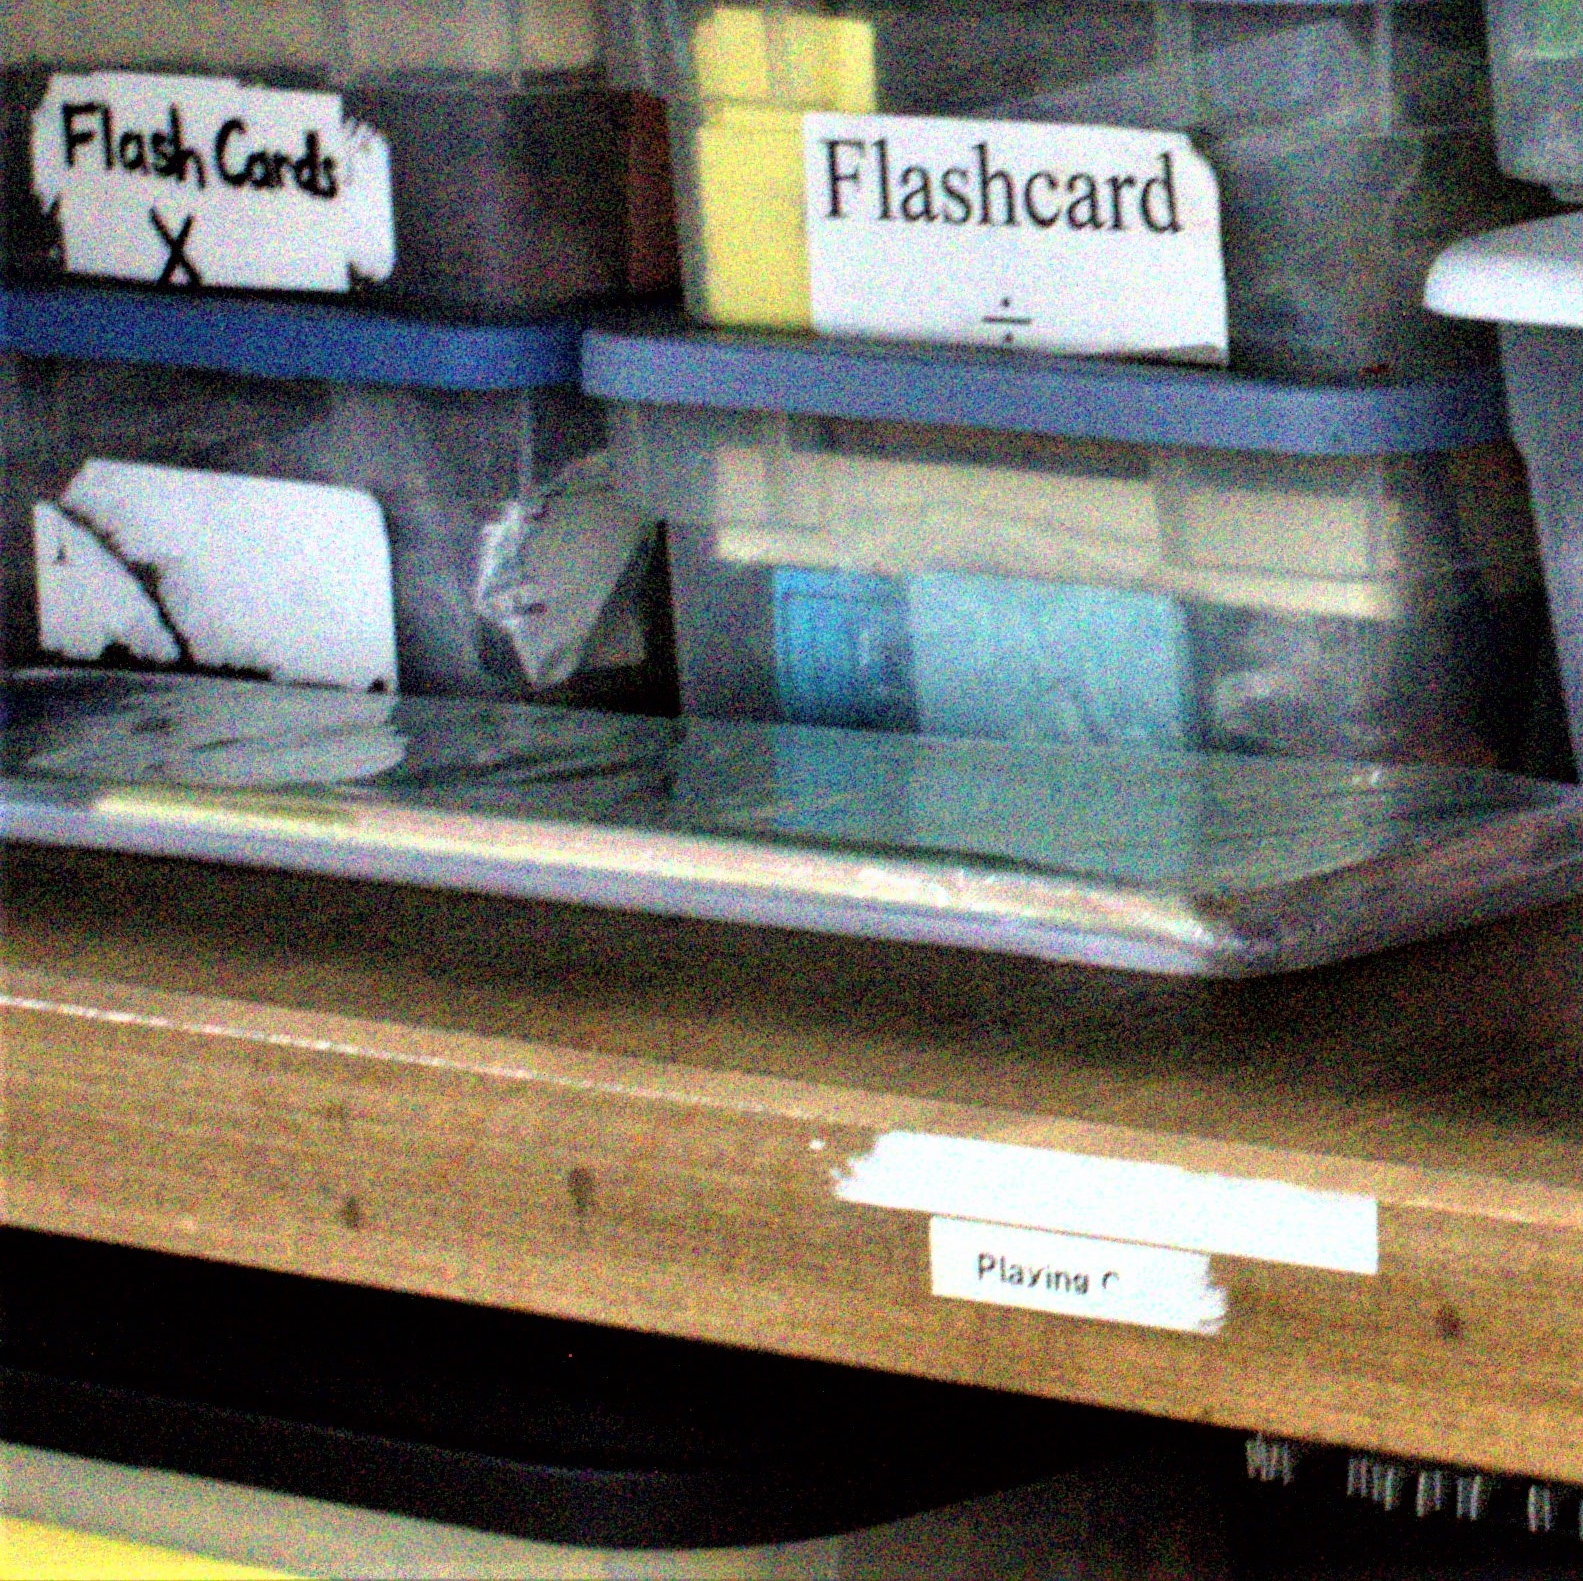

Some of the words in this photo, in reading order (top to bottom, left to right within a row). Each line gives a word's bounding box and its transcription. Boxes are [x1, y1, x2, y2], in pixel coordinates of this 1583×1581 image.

[62, 102, 207, 190] Flash
[214, 118, 339, 199] Cards
[822, 136, 1186, 235] Flashcard
[977, 1251, 1090, 1295] Playing
